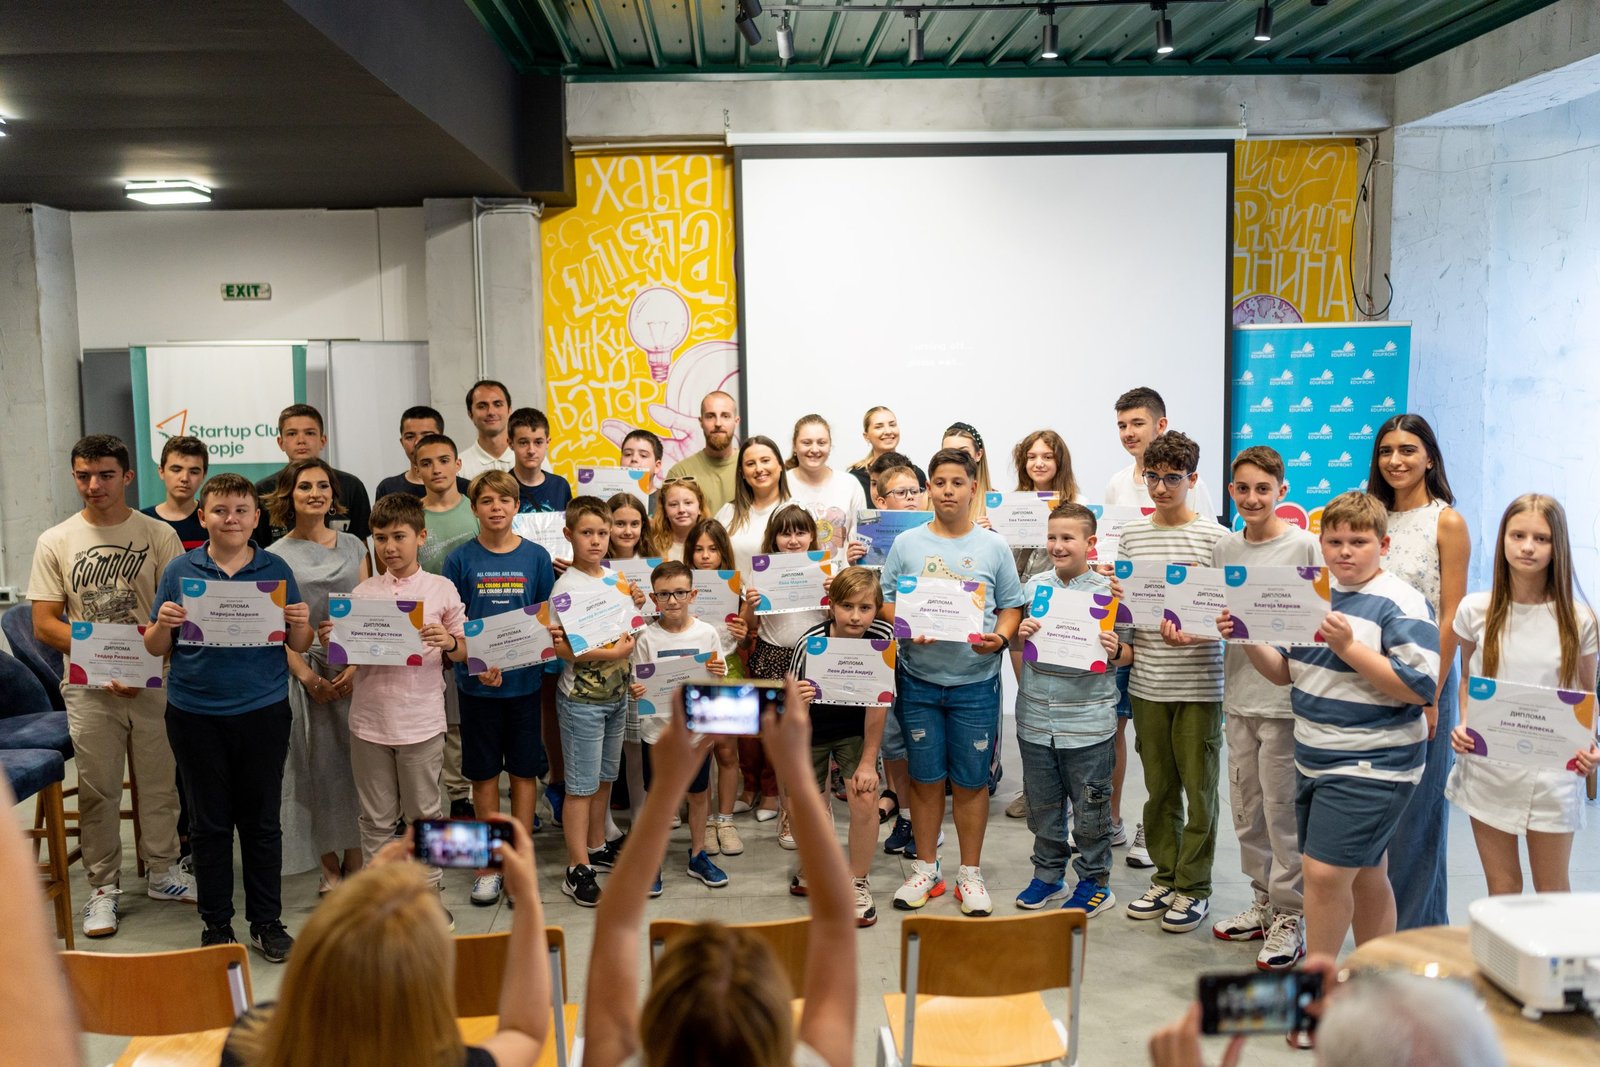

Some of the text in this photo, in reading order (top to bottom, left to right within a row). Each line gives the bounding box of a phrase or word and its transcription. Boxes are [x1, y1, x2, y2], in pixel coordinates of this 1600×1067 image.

[226, 285, 260, 298] EXIT
[189, 424, 280, 440] Startup Clu
[208, 441, 245, 457] opje
[72, 541, 150, 594] Compton
[1510, 711, 1546, 721] ДИПЛОМА
